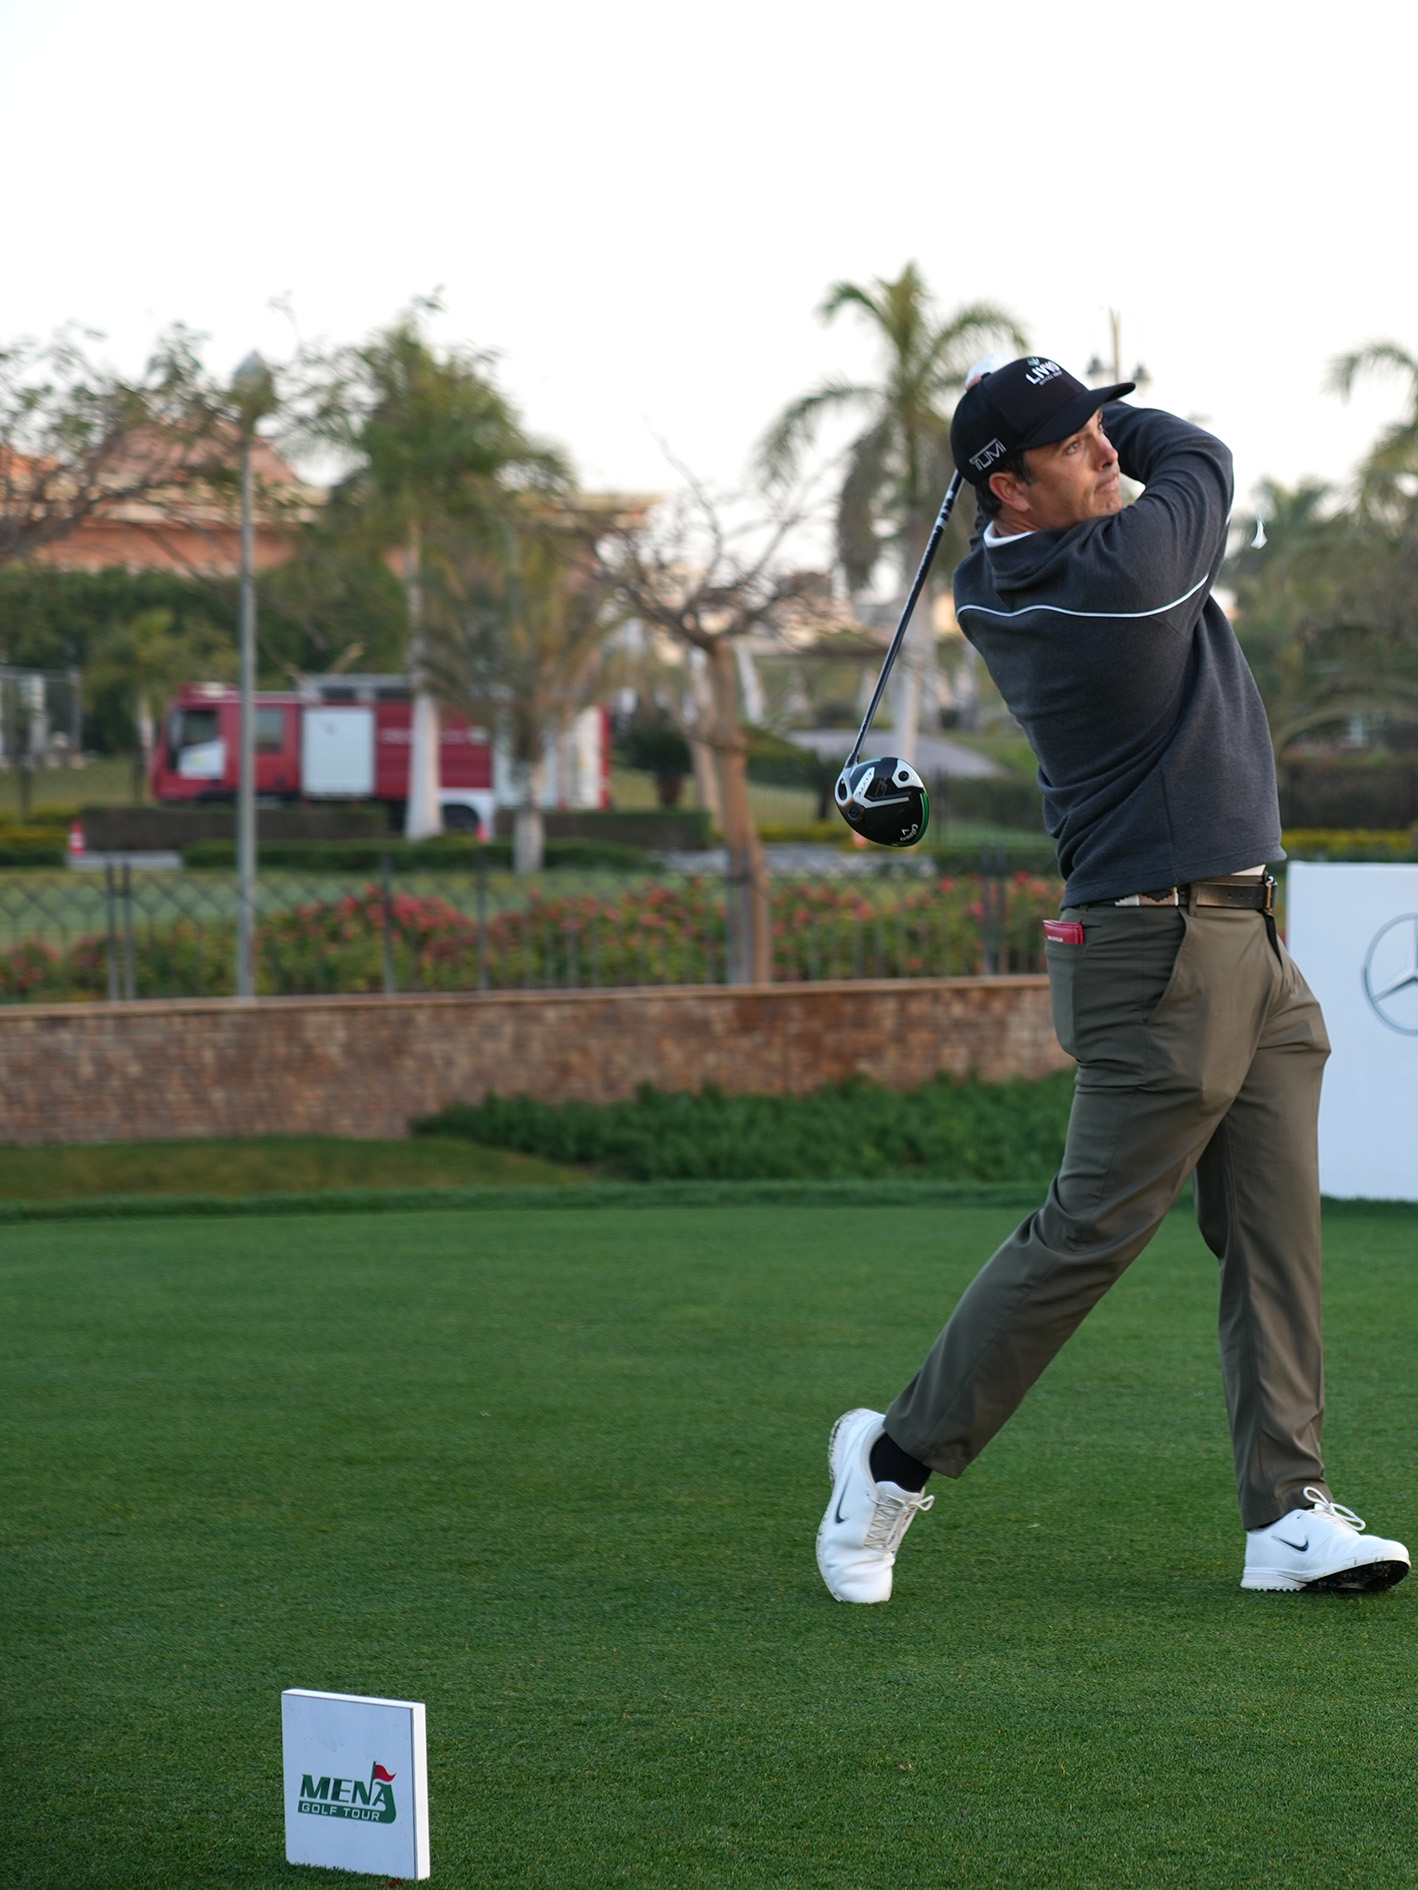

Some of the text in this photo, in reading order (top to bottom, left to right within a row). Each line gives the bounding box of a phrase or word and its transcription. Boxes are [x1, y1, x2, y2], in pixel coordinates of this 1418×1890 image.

[969, 438, 1007, 471] TUMI
[299, 1767, 394, 1808] MENA
[301, 1802, 380, 1822] GOLF TOUR
